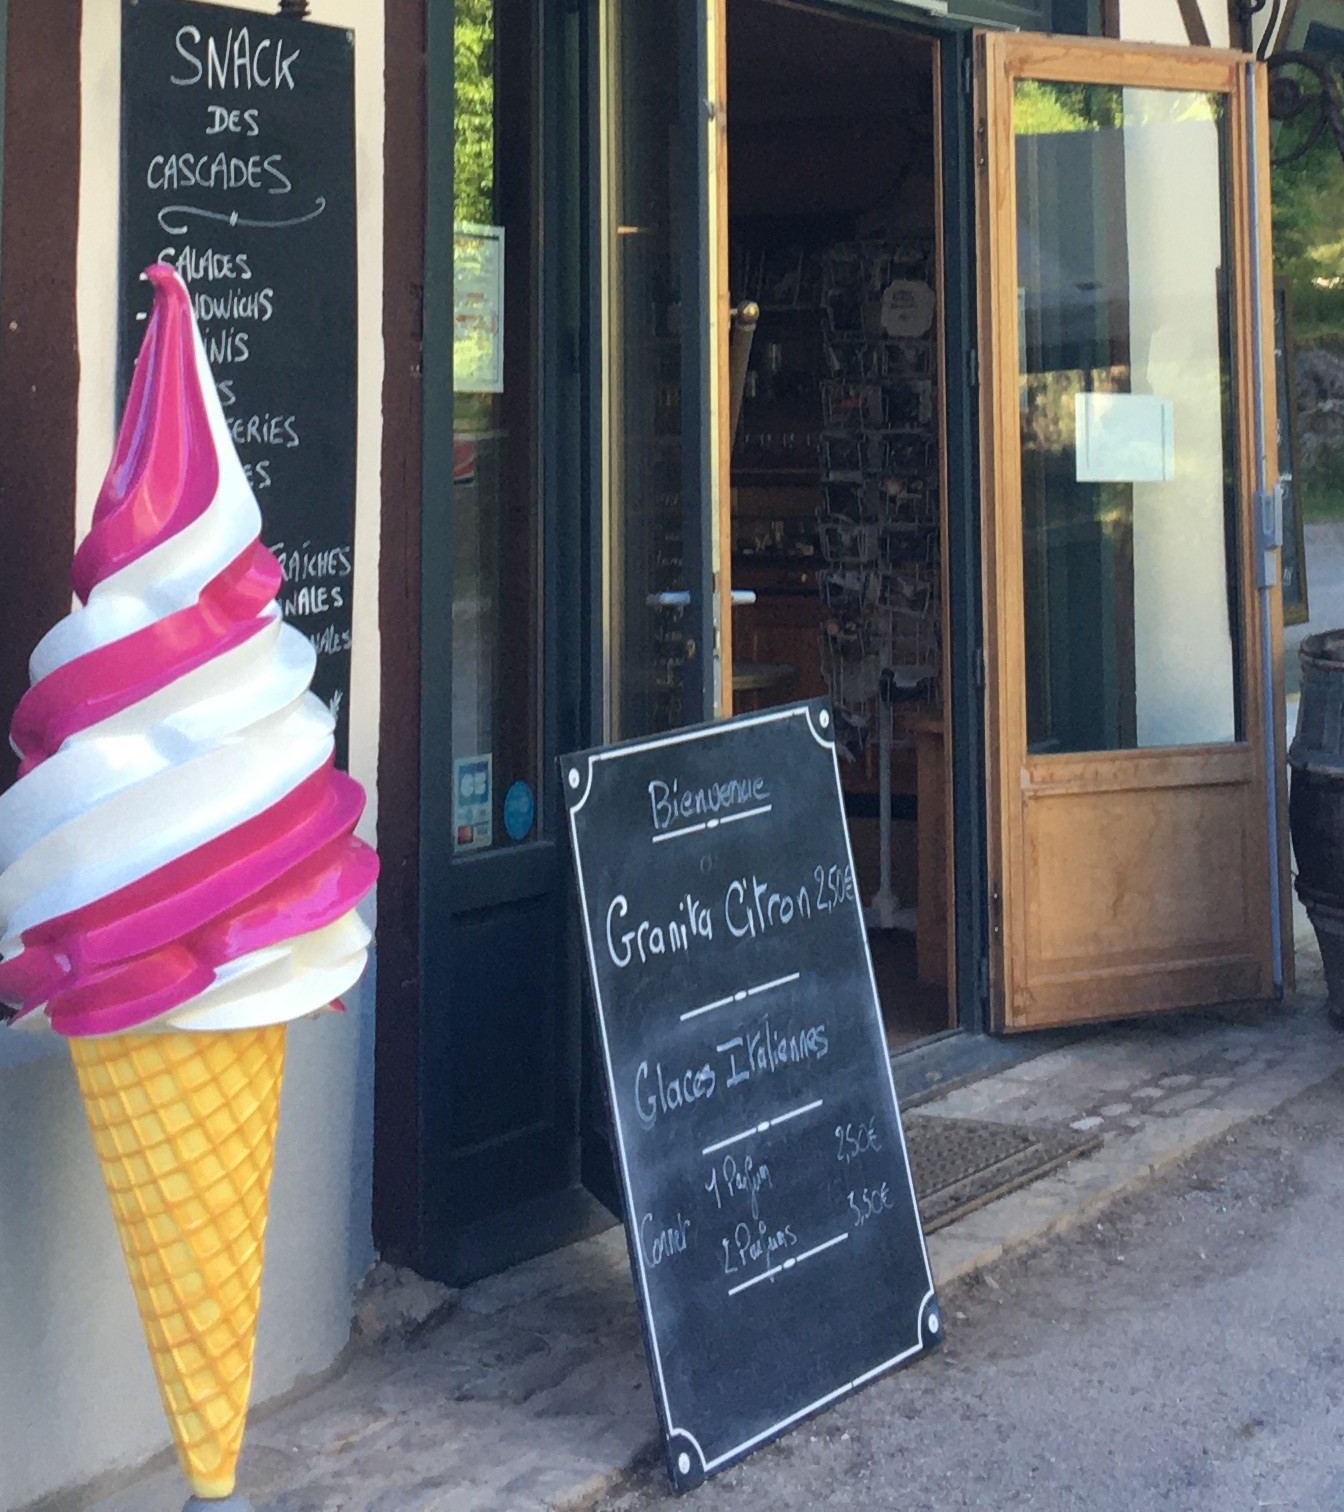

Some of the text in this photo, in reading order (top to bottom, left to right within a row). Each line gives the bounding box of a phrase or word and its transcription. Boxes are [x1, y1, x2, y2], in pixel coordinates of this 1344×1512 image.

[170, 25, 300, 90] SNACK
[206, 105, 260, 136] DES
[147, 152, 292, 194] CASCADES
[648, 777, 770, 829] Bienvenue
[606, 894, 713, 967] Granita
[725, 875, 811, 937] Citron
[635, 1020, 829, 1125] Glaces Italiennes
